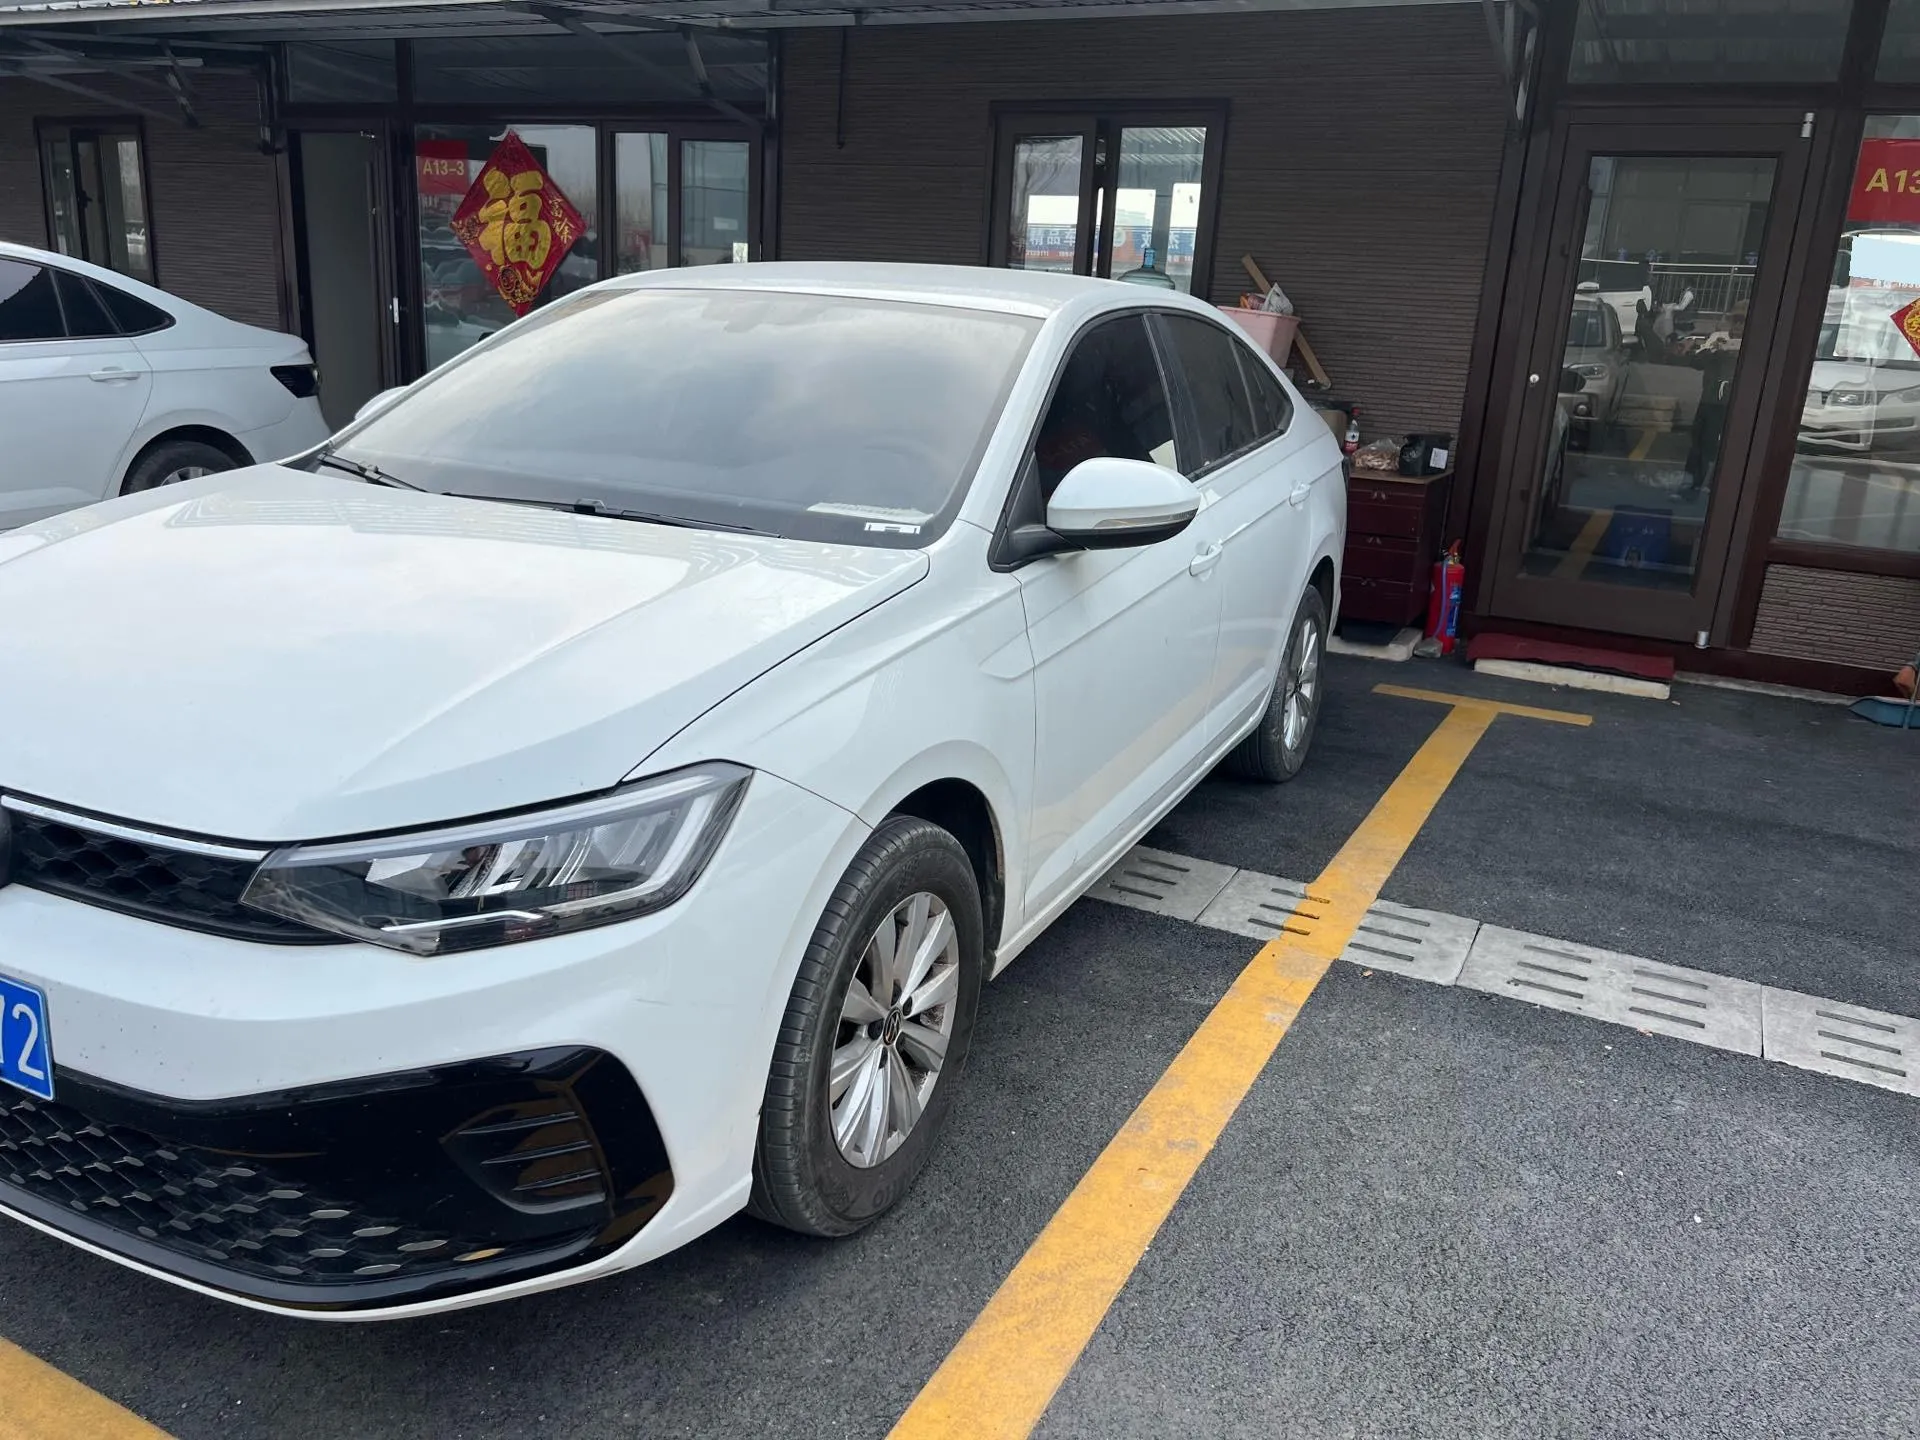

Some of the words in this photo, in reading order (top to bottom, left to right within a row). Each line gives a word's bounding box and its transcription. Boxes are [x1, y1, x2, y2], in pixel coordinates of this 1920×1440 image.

[422, 161, 465, 176] A13-3
[478, 166, 551, 269] 福
[0, 994, 45, 1081] 2
